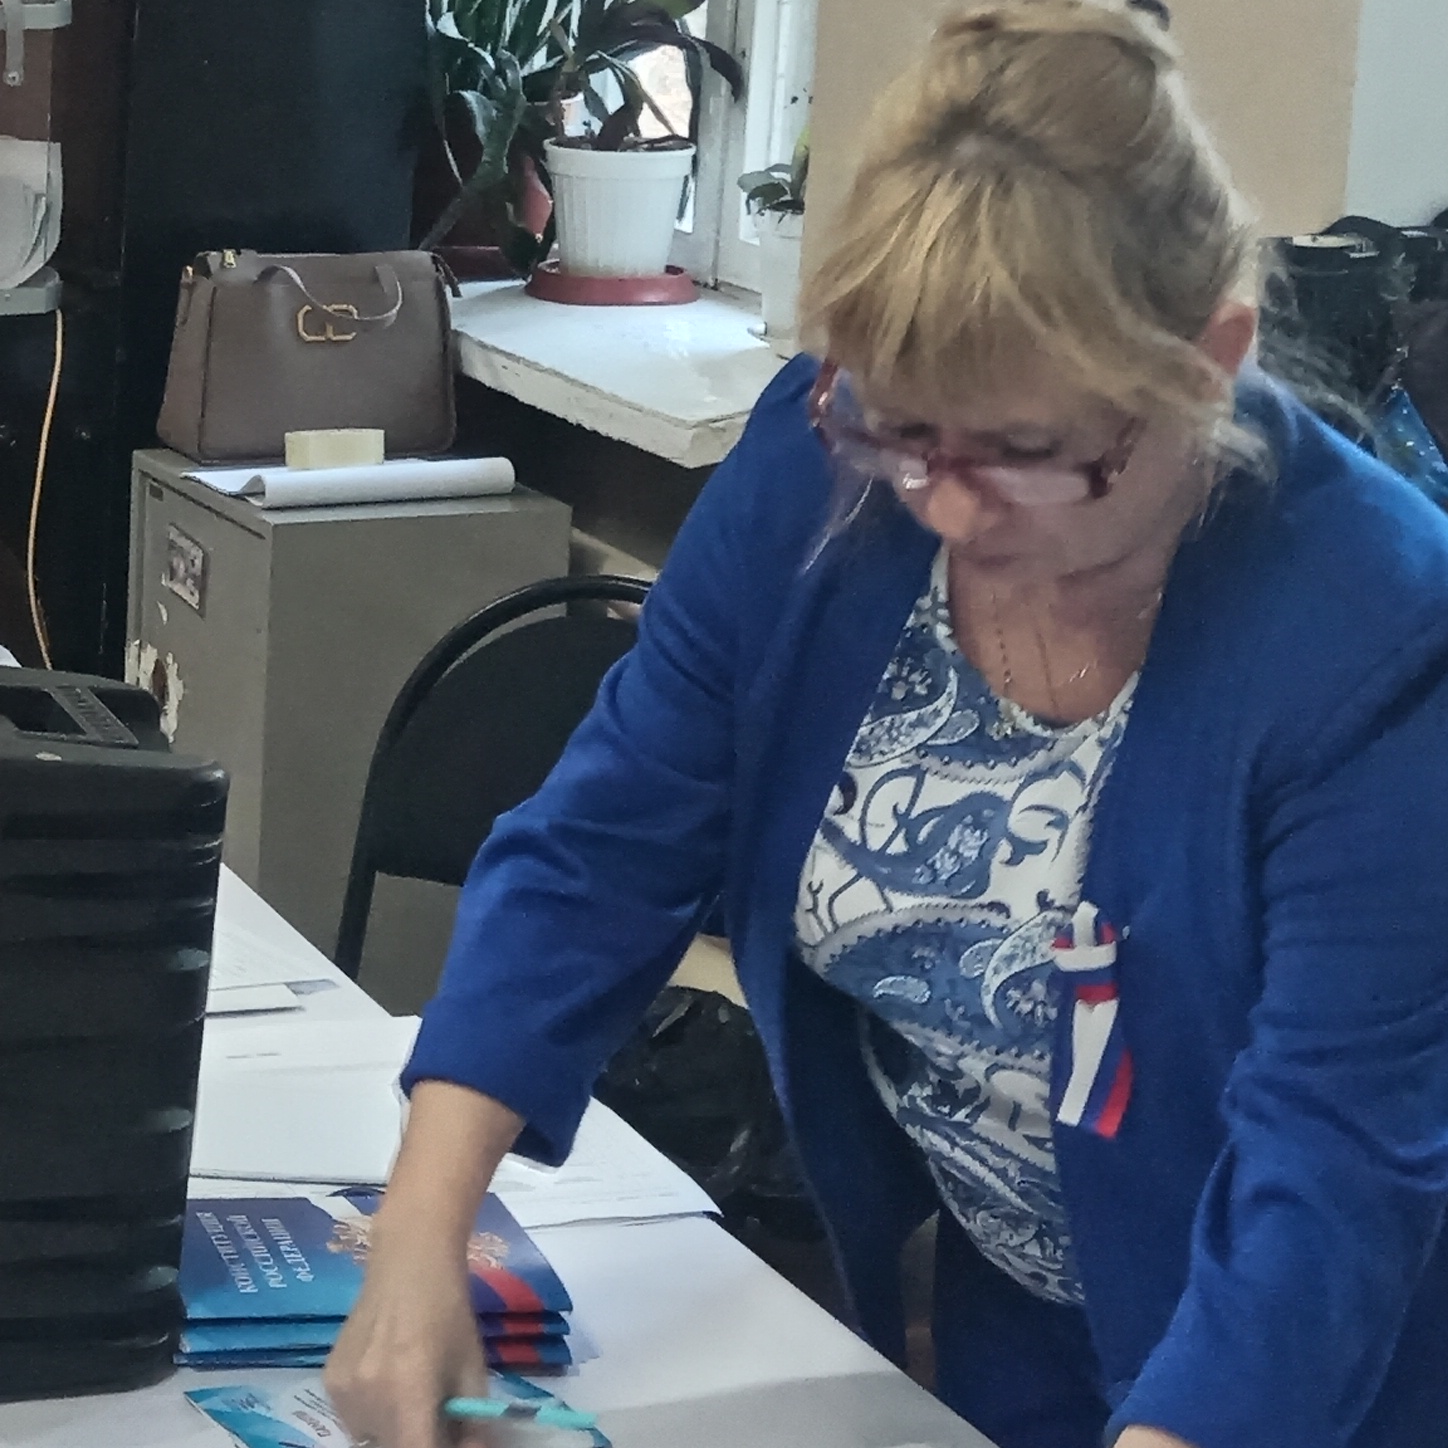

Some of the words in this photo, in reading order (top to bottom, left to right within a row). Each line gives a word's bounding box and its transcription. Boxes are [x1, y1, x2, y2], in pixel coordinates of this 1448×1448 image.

[195, 1211, 260, 1294] КОНСТИТУЦИЯ
[225, 1214, 288, 1289] РОССИЙСКОЙ
[260, 1218, 315, 1283] ФЕДЕРАЦИИ
